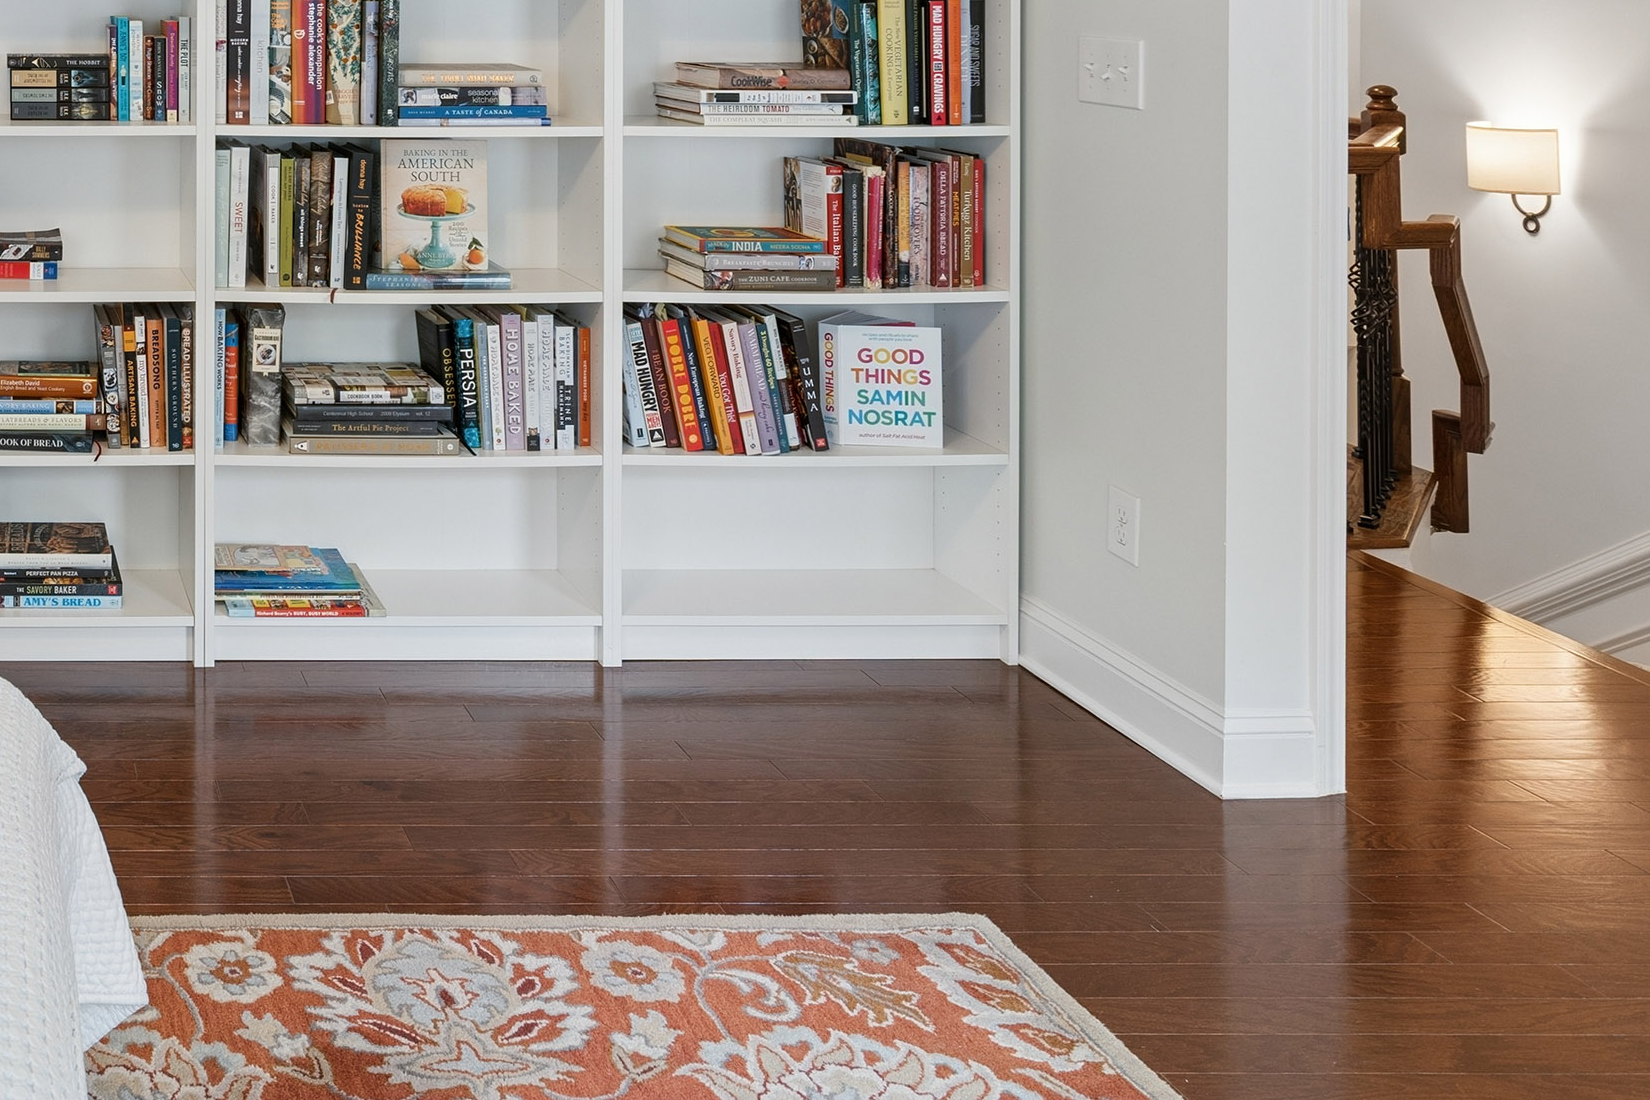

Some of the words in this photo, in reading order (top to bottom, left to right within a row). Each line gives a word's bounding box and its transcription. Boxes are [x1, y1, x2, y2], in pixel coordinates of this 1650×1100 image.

[236, 13, 244, 24] hay
[306, 3, 315, 42] stephanie
[933, 5, 942, 24] MAD
[933, 25, 942, 59] HUNGRY
[730, 75, 772, 87] CookWise
[934, 73, 944, 113] CRAVINGS
[397, 158, 474, 169] AMERICAN
[411, 171, 460, 182] SOUTH
[234, 202, 243, 233] SWEET
[962, 190, 972, 224] Turkuaz
[353, 213, 364, 270] BRILLIANCE
[732, 242, 763, 251] INDIA
[152, 329, 160, 390] BREADSONG
[506, 329, 519, 375] HOME
[632, 342, 646, 366] MAD
[824, 332, 834, 368] GOOD
[857, 348, 924, 365] GOOD
[127, 360, 136, 394] ARTISAN
[443, 348, 456, 408] OBSESSED
[460, 348, 477, 407] PERSIA
[703, 337, 711, 355] VEG
[707, 356, 720, 399] FORWARD
[851, 368, 931, 386] THINGS
[637, 369, 658, 412] HUNGRY
[825, 370, 834, 412] THINGS
[857, 388, 926, 406] SAMIN
[129, 396, 137, 427] BAKING
[508, 381, 521, 434] BAKED
[848, 409, 936, 427] NOSRAT
[20, 438, 32, 446] OF
[33, 439, 64, 448] BREAD
[24, 597, 59, 606] AMY'S
[62, 598, 102, 606] BREAD
